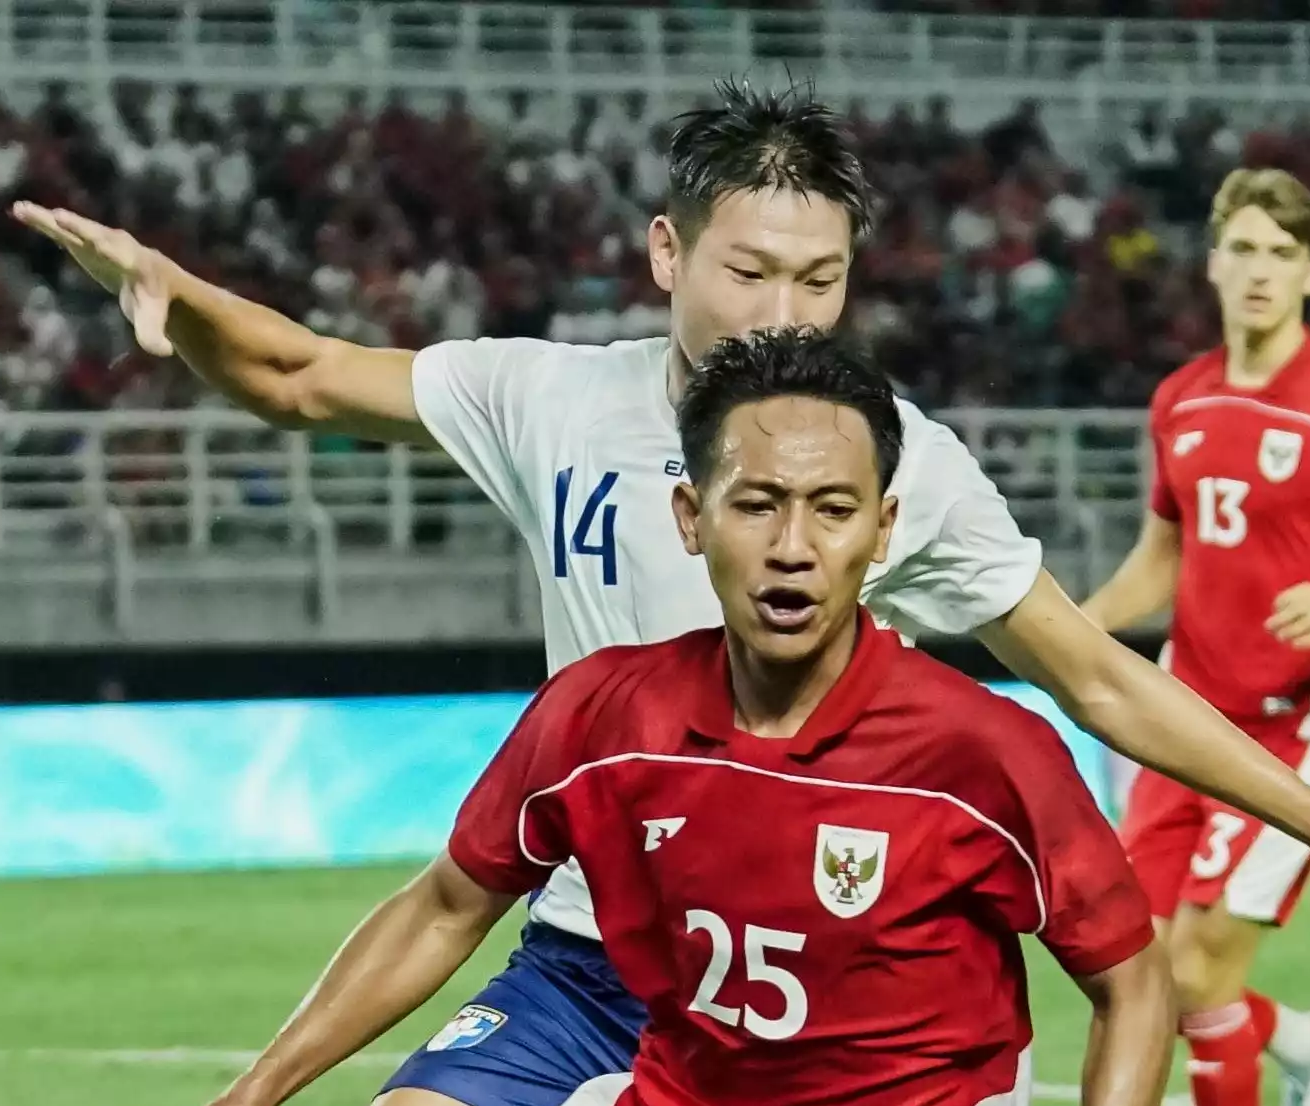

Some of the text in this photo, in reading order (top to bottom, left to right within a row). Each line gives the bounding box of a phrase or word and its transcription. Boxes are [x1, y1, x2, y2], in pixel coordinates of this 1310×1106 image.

[554, 465, 620, 586] 14
[1197, 476, 1250, 548] 13
[685, 909, 808, 1041] 25
